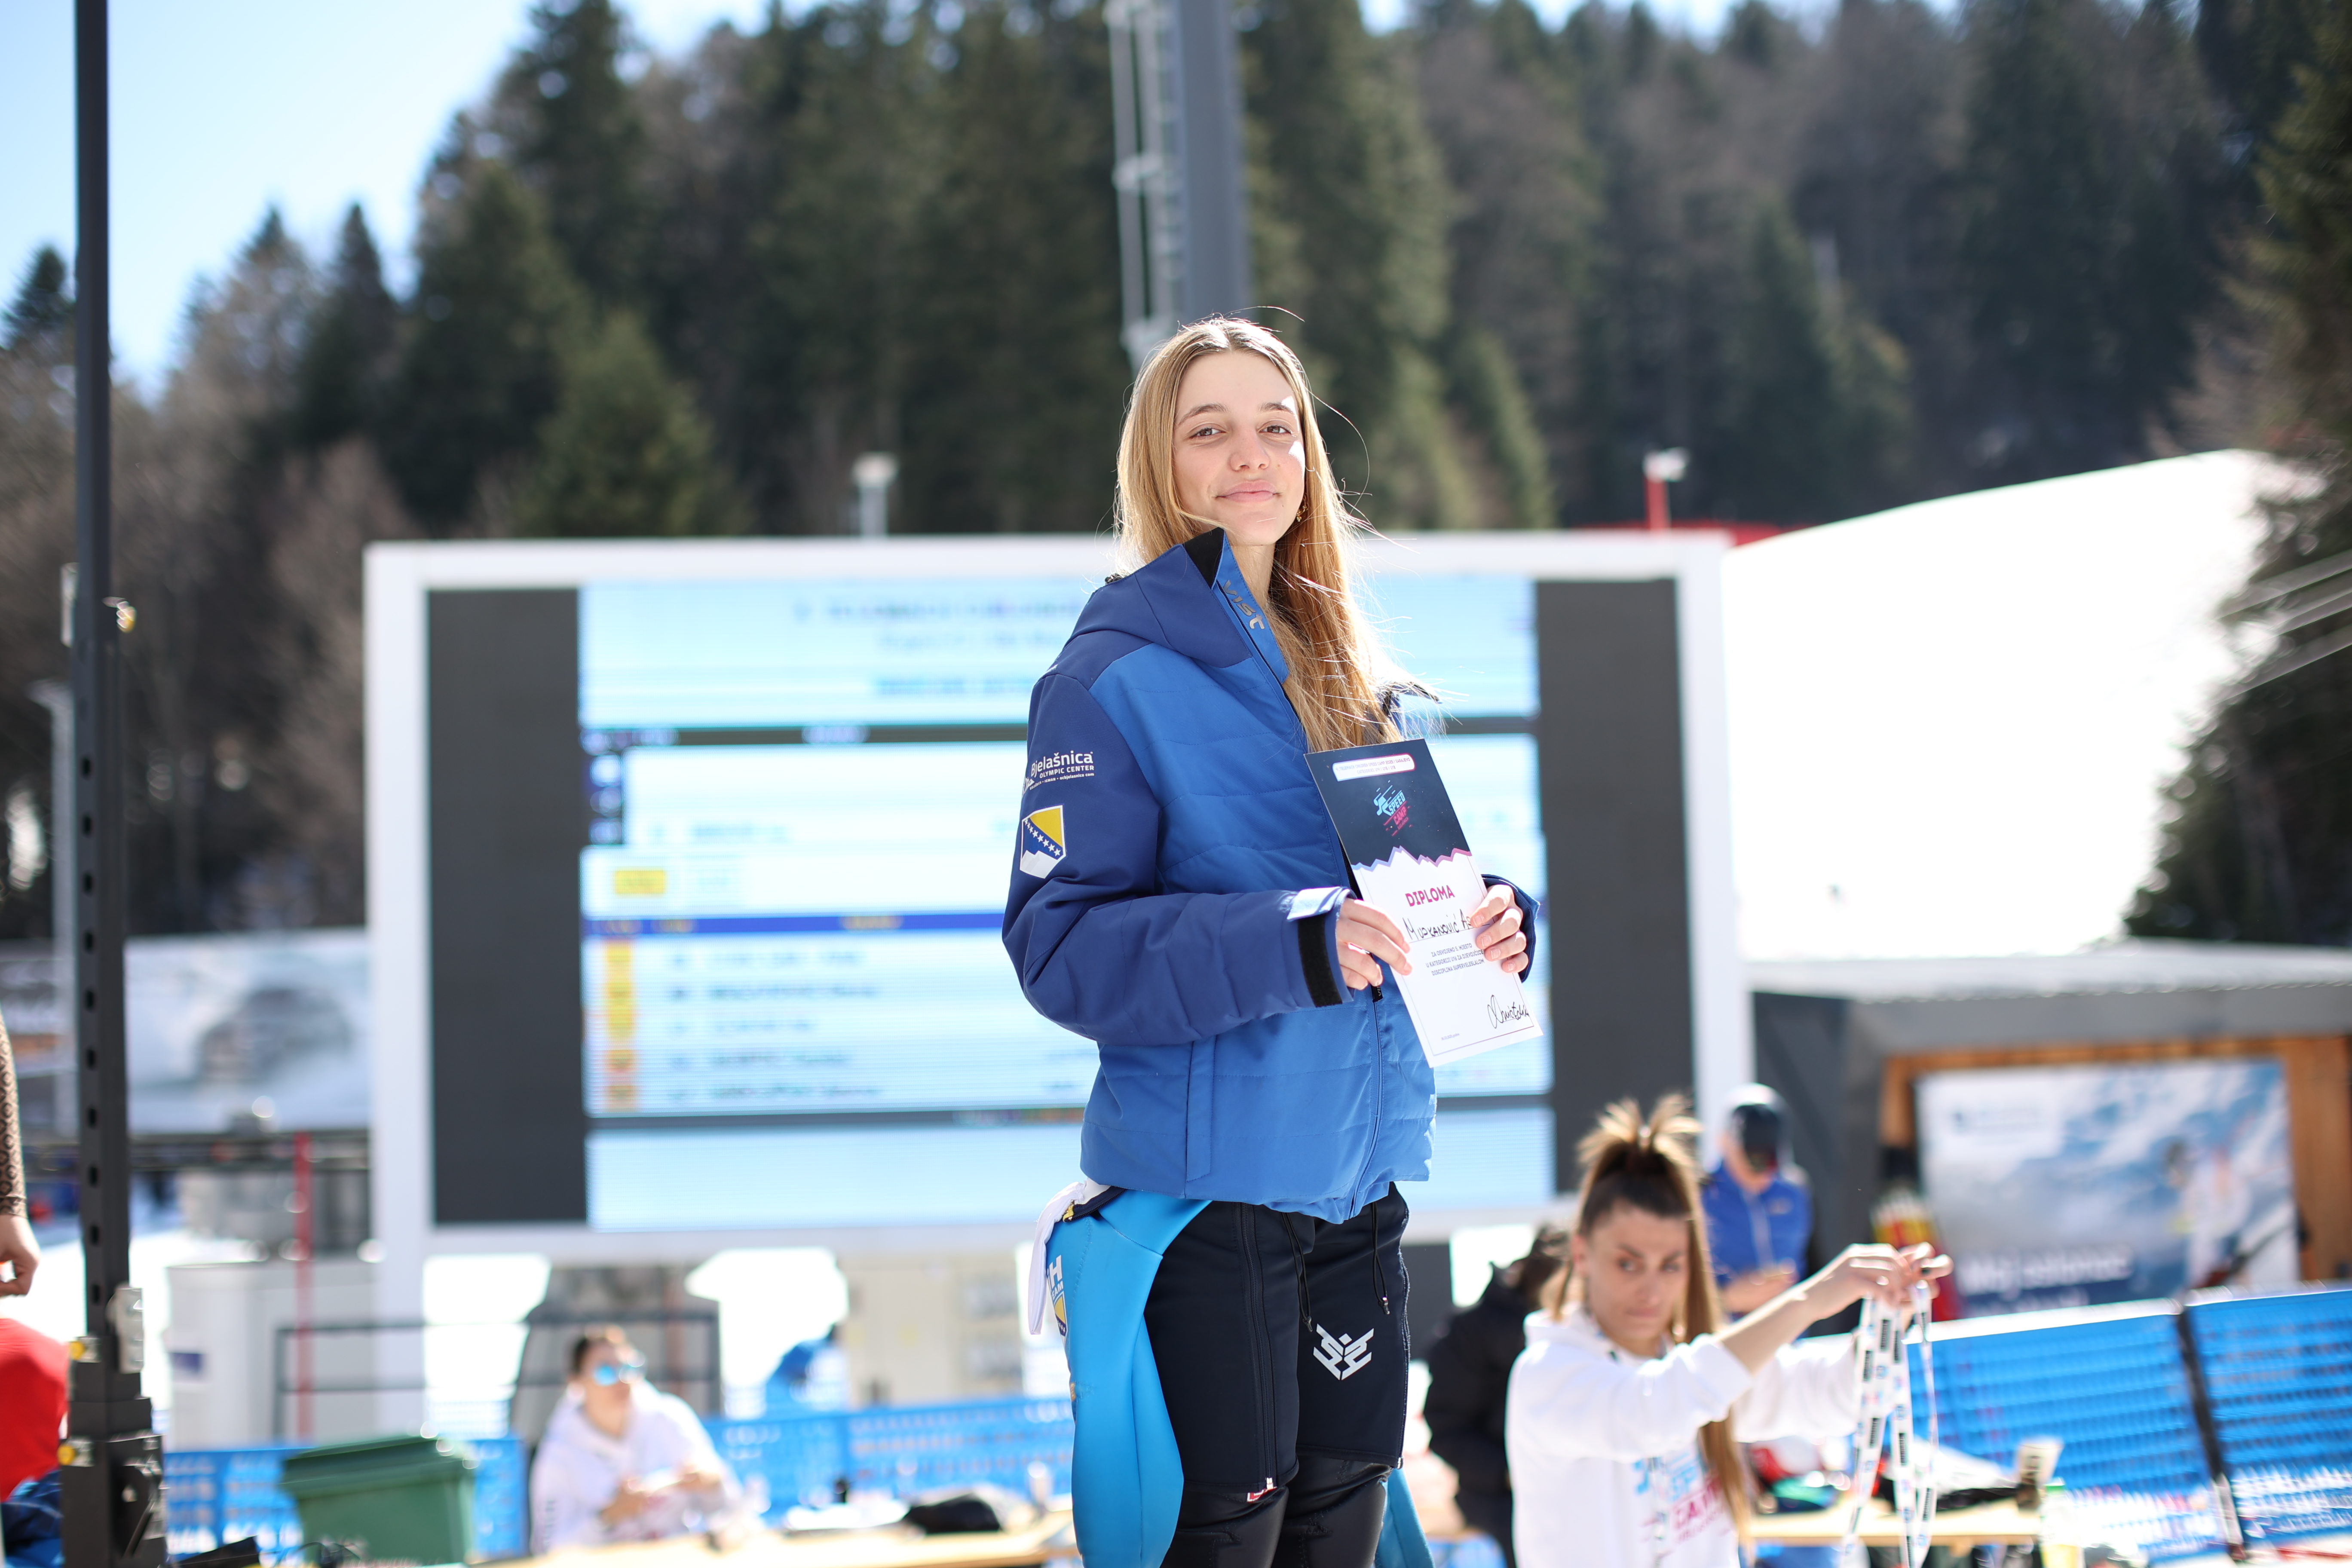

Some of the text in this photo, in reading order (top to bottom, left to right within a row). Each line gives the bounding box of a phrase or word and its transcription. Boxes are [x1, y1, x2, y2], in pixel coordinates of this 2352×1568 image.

[1031, 750, 1093, 778] Bjelašnica
[1039, 768, 1065, 778] OLYMPIC
[1388, 792, 1406, 815] SPEED
[1393, 806, 1407, 825] CAMP
[1405, 885, 1455, 906] DIPLOMA
[1429, 957, 1452, 967] KATEGORIJI
[1462, 949, 1484, 959] DJEVOJČICE
[1436, 947, 1455, 956] OSVOJENO
[1431, 959, 1485, 976] DISCIPLINA SUPERVELESLALOM
[1052, 1280, 1063, 1300] EAM
